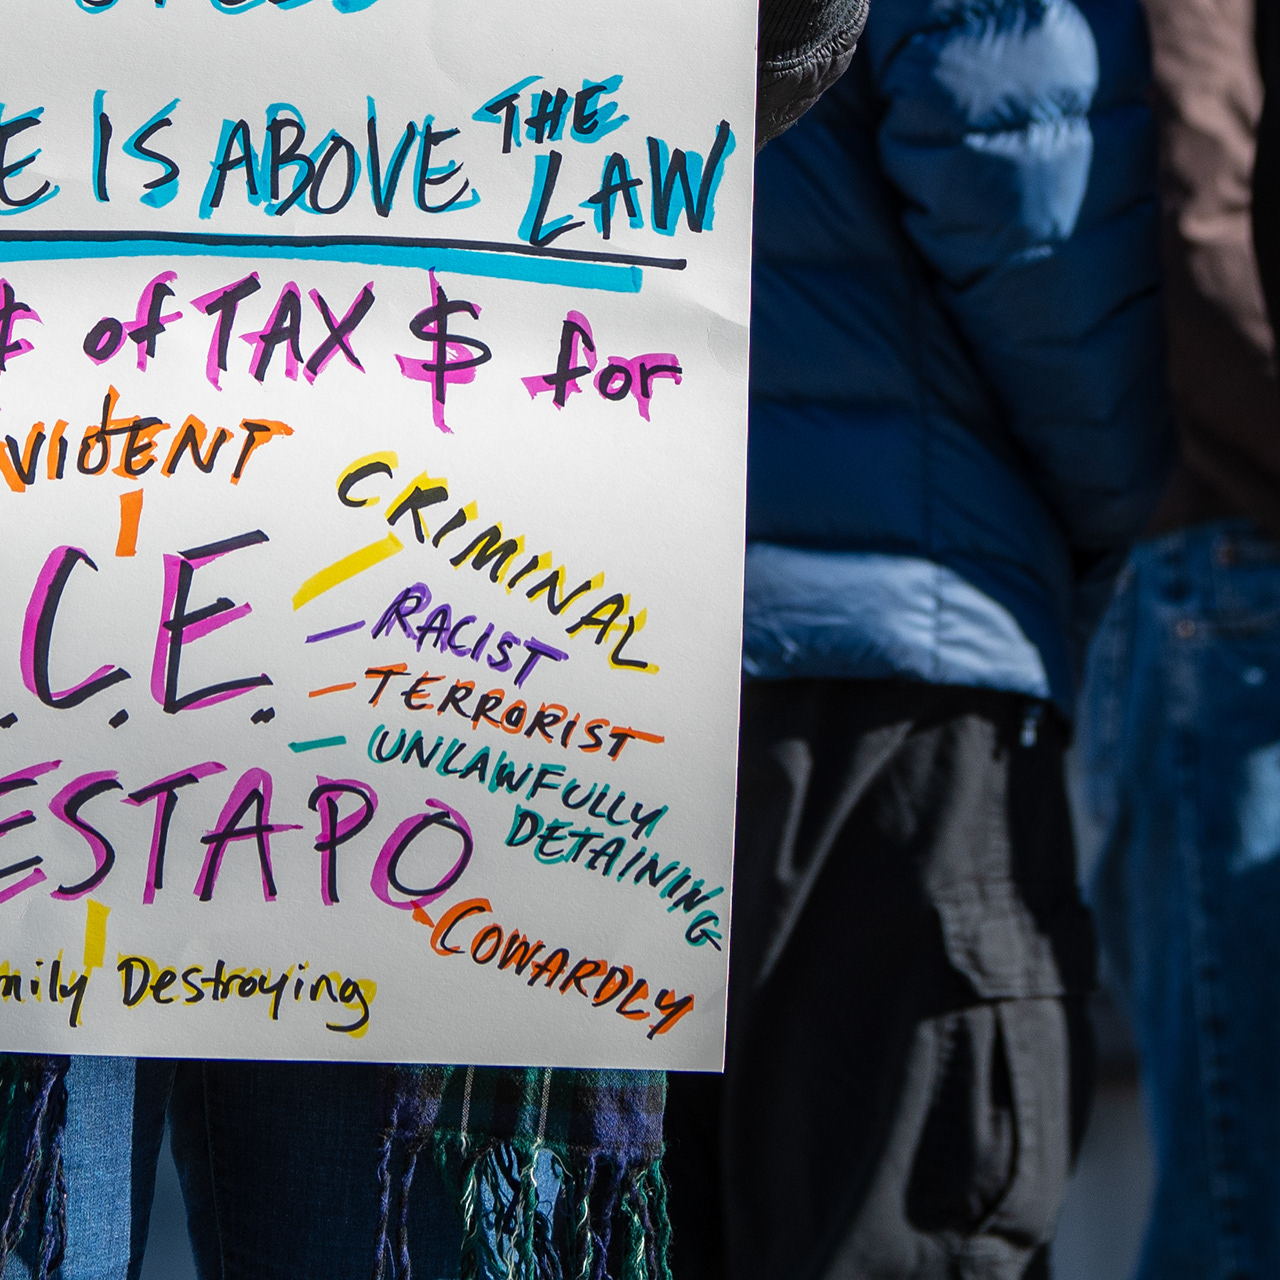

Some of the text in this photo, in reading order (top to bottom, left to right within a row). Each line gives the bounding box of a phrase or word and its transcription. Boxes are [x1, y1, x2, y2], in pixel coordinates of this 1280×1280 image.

[93, 89, 181, 208] IS
[198, 96, 480, 219] ABOVE
[472, 75, 630, 153] THE
[518, 119, 736, 246] LAW
[83, 270, 183, 371] of
[189, 271, 375, 391] TAX
[395, 266, 493, 433] $
[519, 310, 682, 421] for
[336, 450, 659, 673] CRIMINAL
[372, 582, 568, 687] RACIST
[363, 663, 664, 760] TERRORIST
[368, 724, 668, 839] UNLAWFULLY
[506, 805, 725, 951] DETAINING
[117, 954, 377, 1038] Destroying
[430, 898, 695, 1040] COWARDLY
